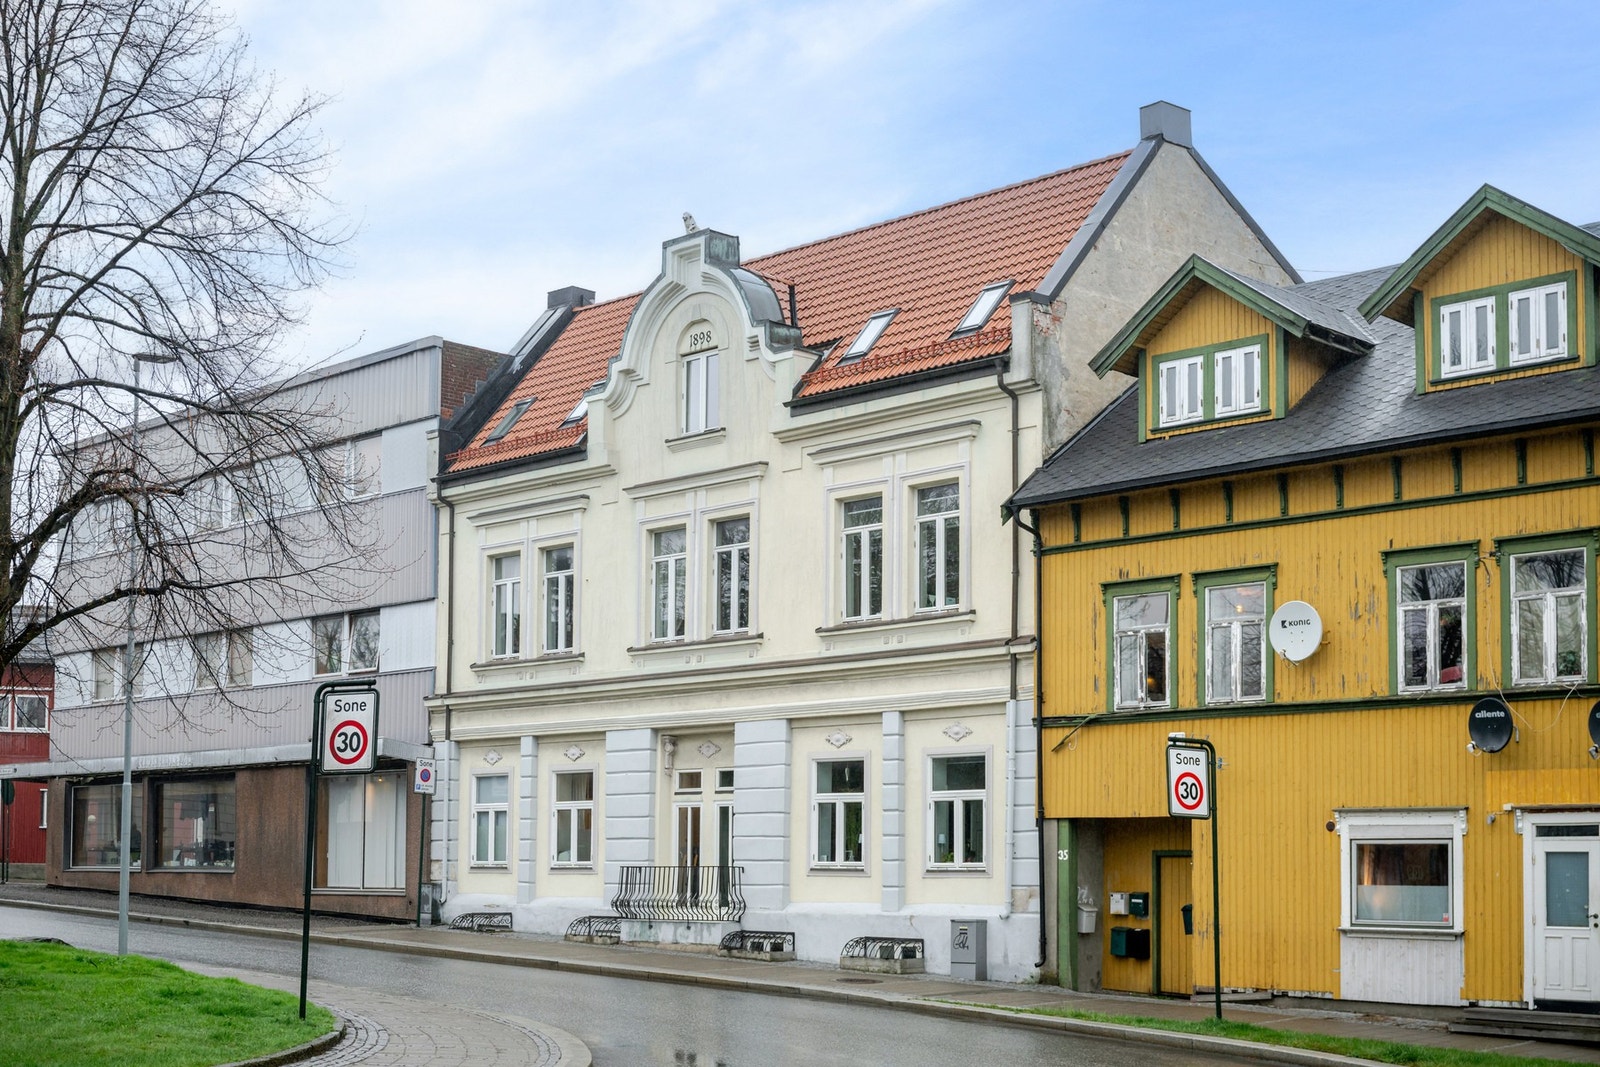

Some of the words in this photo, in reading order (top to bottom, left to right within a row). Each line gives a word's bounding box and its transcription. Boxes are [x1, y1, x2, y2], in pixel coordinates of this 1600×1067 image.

[689, 330, 712, 347] 1898
[334, 699, 367, 713] Sone
[1475, 710, 1505, 718] allente
[336, 731, 361, 753] 30
[1175, 753, 1201, 766] Sone
[1180, 781, 1199, 800] 30
[1058, 849, 1069, 860] 35
